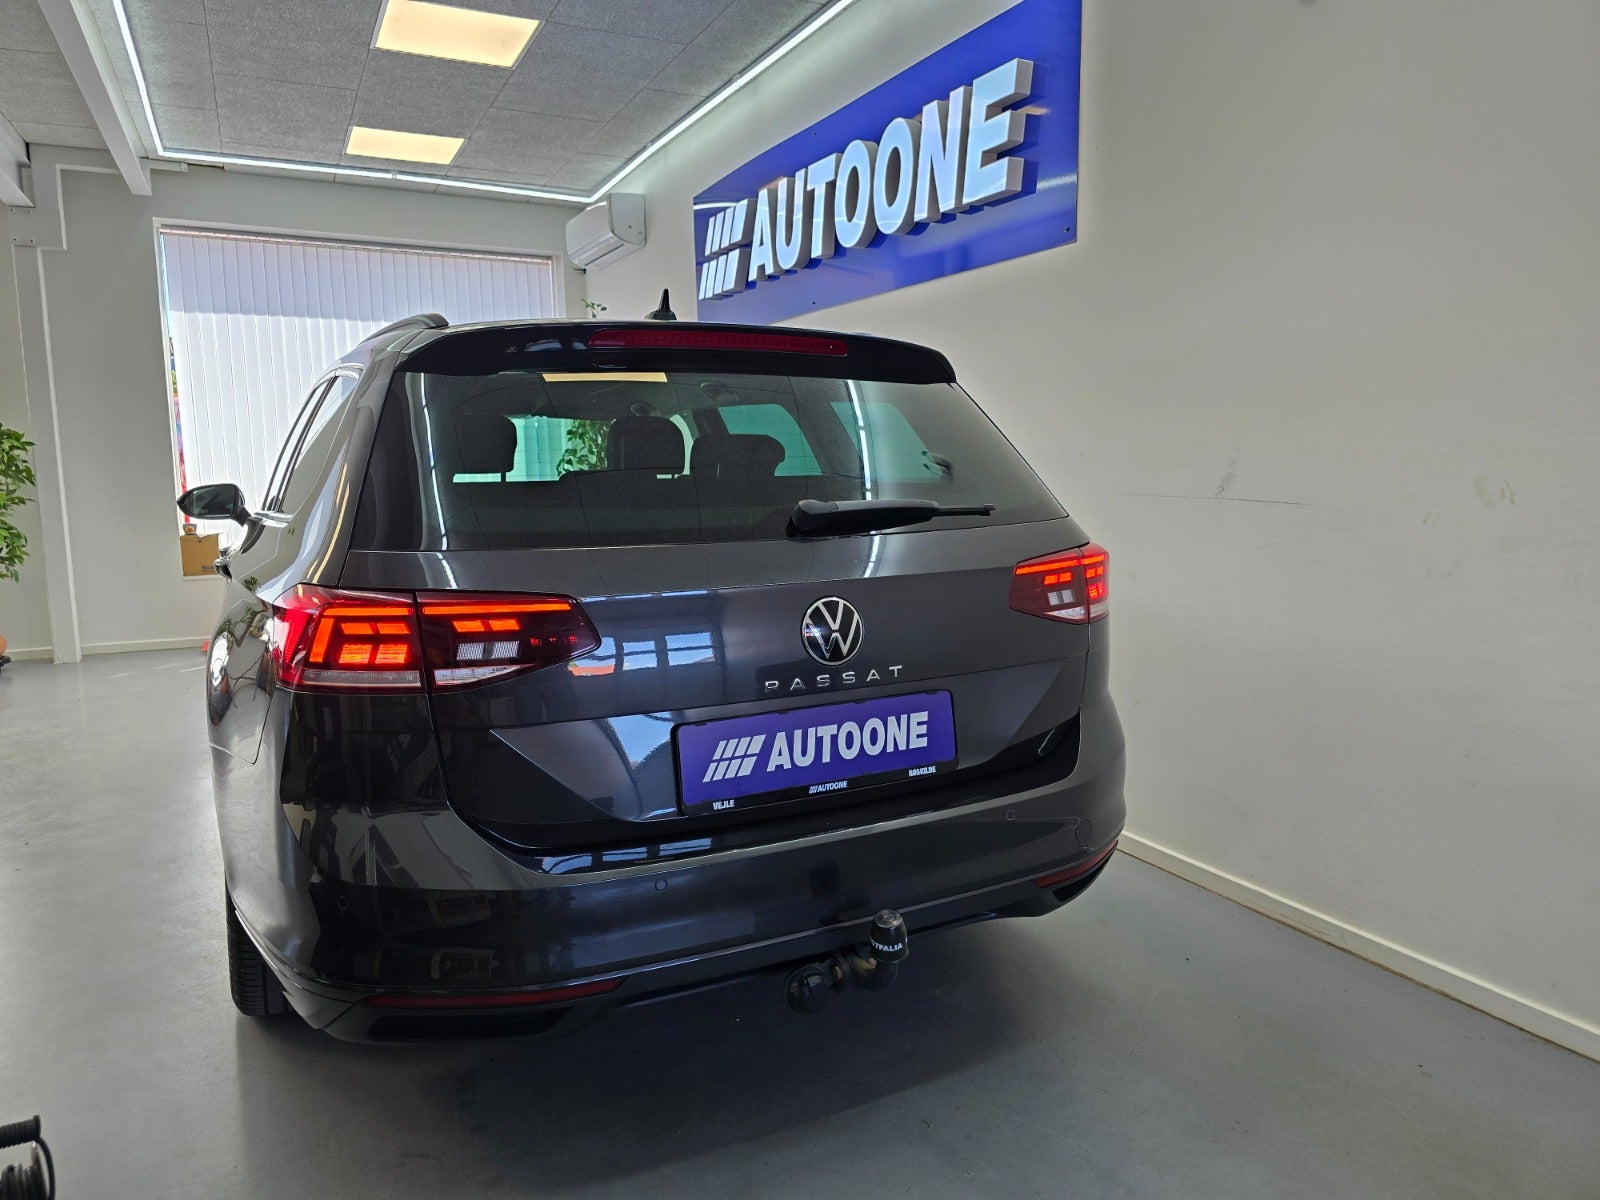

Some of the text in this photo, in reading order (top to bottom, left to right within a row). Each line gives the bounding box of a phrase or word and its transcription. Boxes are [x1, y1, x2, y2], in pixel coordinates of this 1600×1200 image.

[749, 58, 1033, 282] AUTOONE
[765, 665, 903, 692] PASSAT
[766, 711, 929, 772] AUTOONE
[817, 780, 848, 793] AUTOONE
[713, 799, 735, 811] VEJLE
